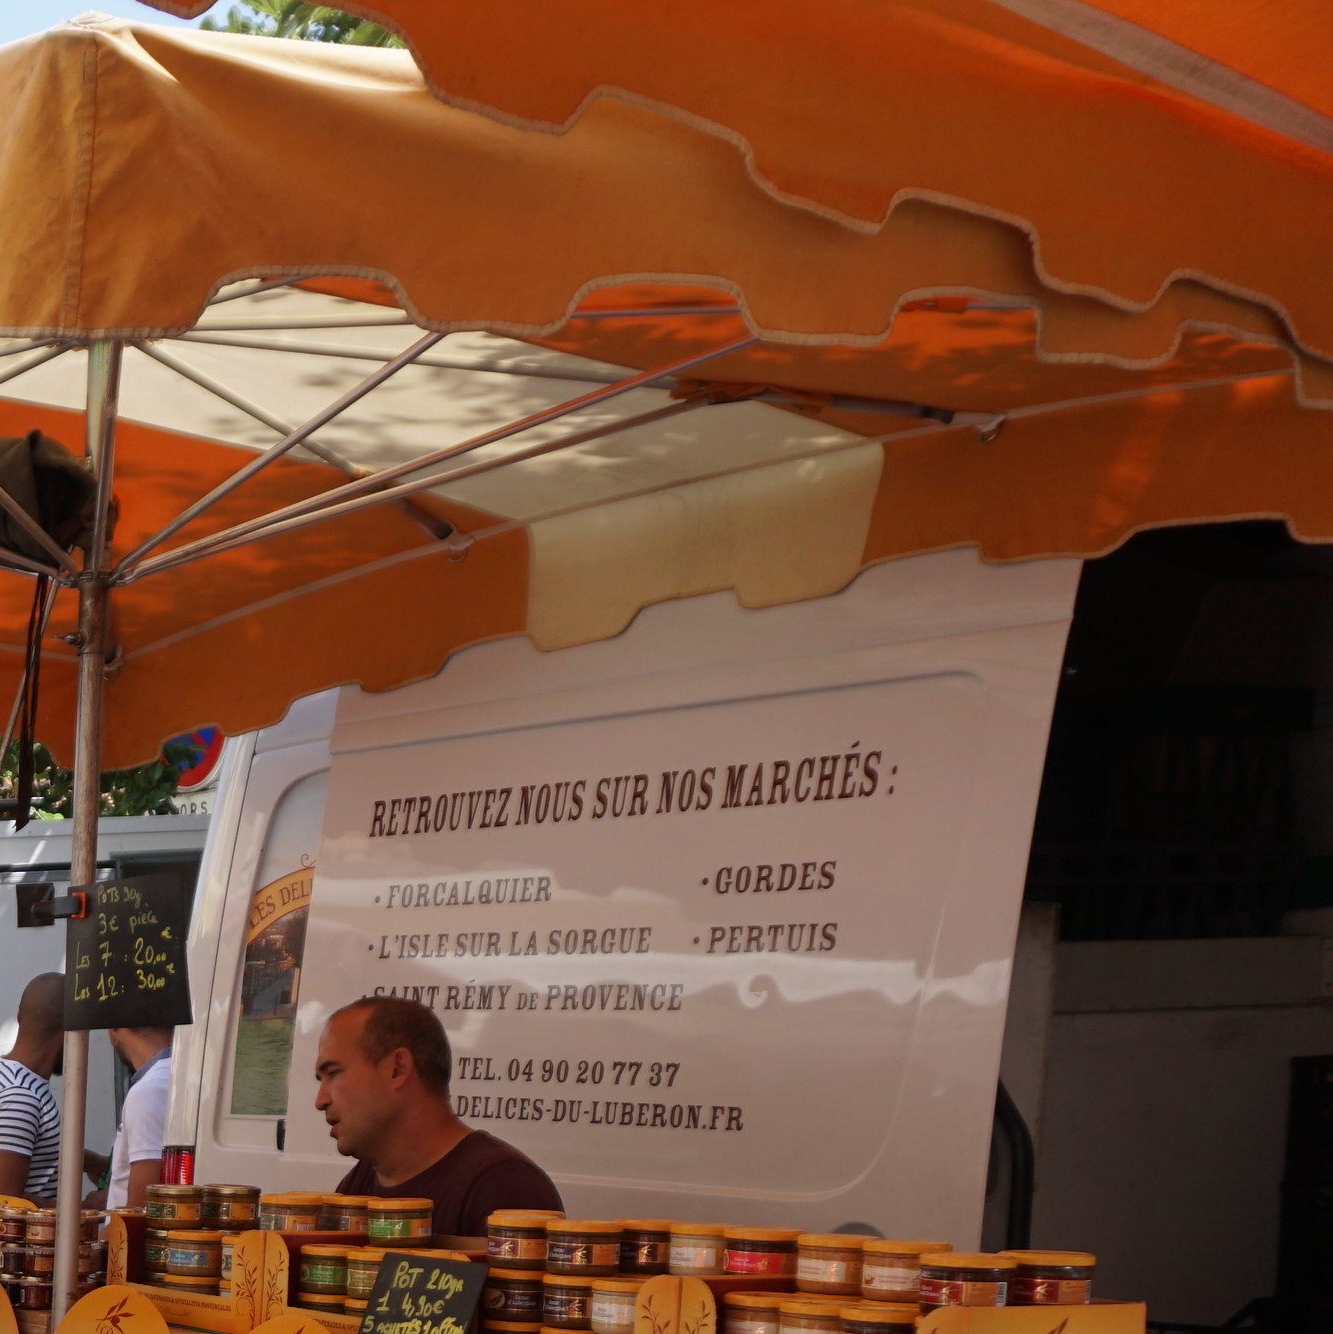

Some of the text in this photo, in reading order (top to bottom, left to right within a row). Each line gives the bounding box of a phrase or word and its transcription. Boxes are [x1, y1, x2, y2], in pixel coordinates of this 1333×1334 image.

[369, 787, 513, 837] RETROUVEZ
[515, 779, 587, 825] NOUS
[592, 773, 650, 820] SUR
[656, 766, 716, 814] NOS
[721, 740, 882, 808] MARCHÉS
[180, 801, 208, 815] ORS
[386, 876, 552, 909] FORCALQUIER
[715, 861, 837, 894] GORDES
[379, 927, 652, 959] L'ISLE SUR LA SORGUE
[707, 923, 838, 953] PERTUIS
[100, 941, 113, 967] 7
[445, 980, 512, 1010] RÉMY
[516, 993, 539, 1010] DE
[545, 983, 684, 1010] PROVENCE
[459, 1057, 681, 1087] TEL. 04 90 20 77 37
[450, 1095, 744, 1131] DELICES-DU-LUBERON.FR
